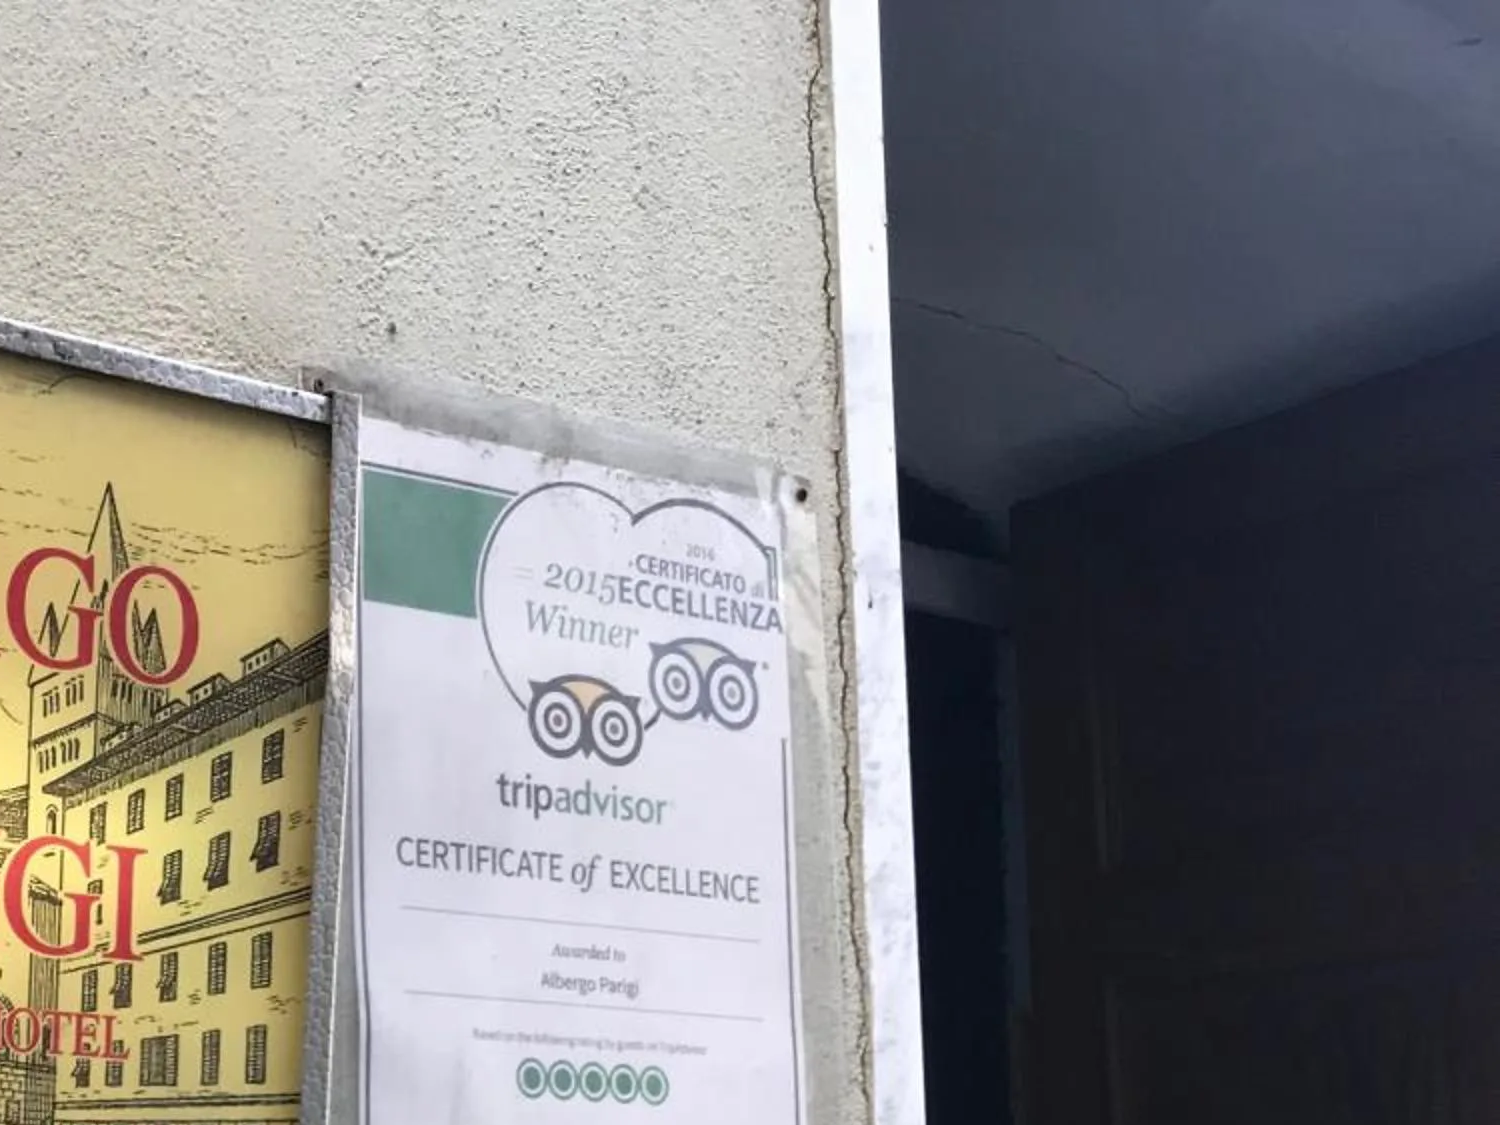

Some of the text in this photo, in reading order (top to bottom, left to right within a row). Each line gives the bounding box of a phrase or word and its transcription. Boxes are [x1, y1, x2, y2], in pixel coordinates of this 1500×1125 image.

[544, 563, 618, 606] 2015
[635, 554, 747, 594] CERTIFICATO
[525, 600, 640, 649] Winner
[618, 575, 784, 634] ECCELLENZA
[496, 773, 668, 825] tripadvisor
[396, 837, 761, 904] CERTIFICATE of EXCELLENCE
[551, 943, 611, 961] Awarded
[541, 971, 639, 1001] Albergo Parigi
